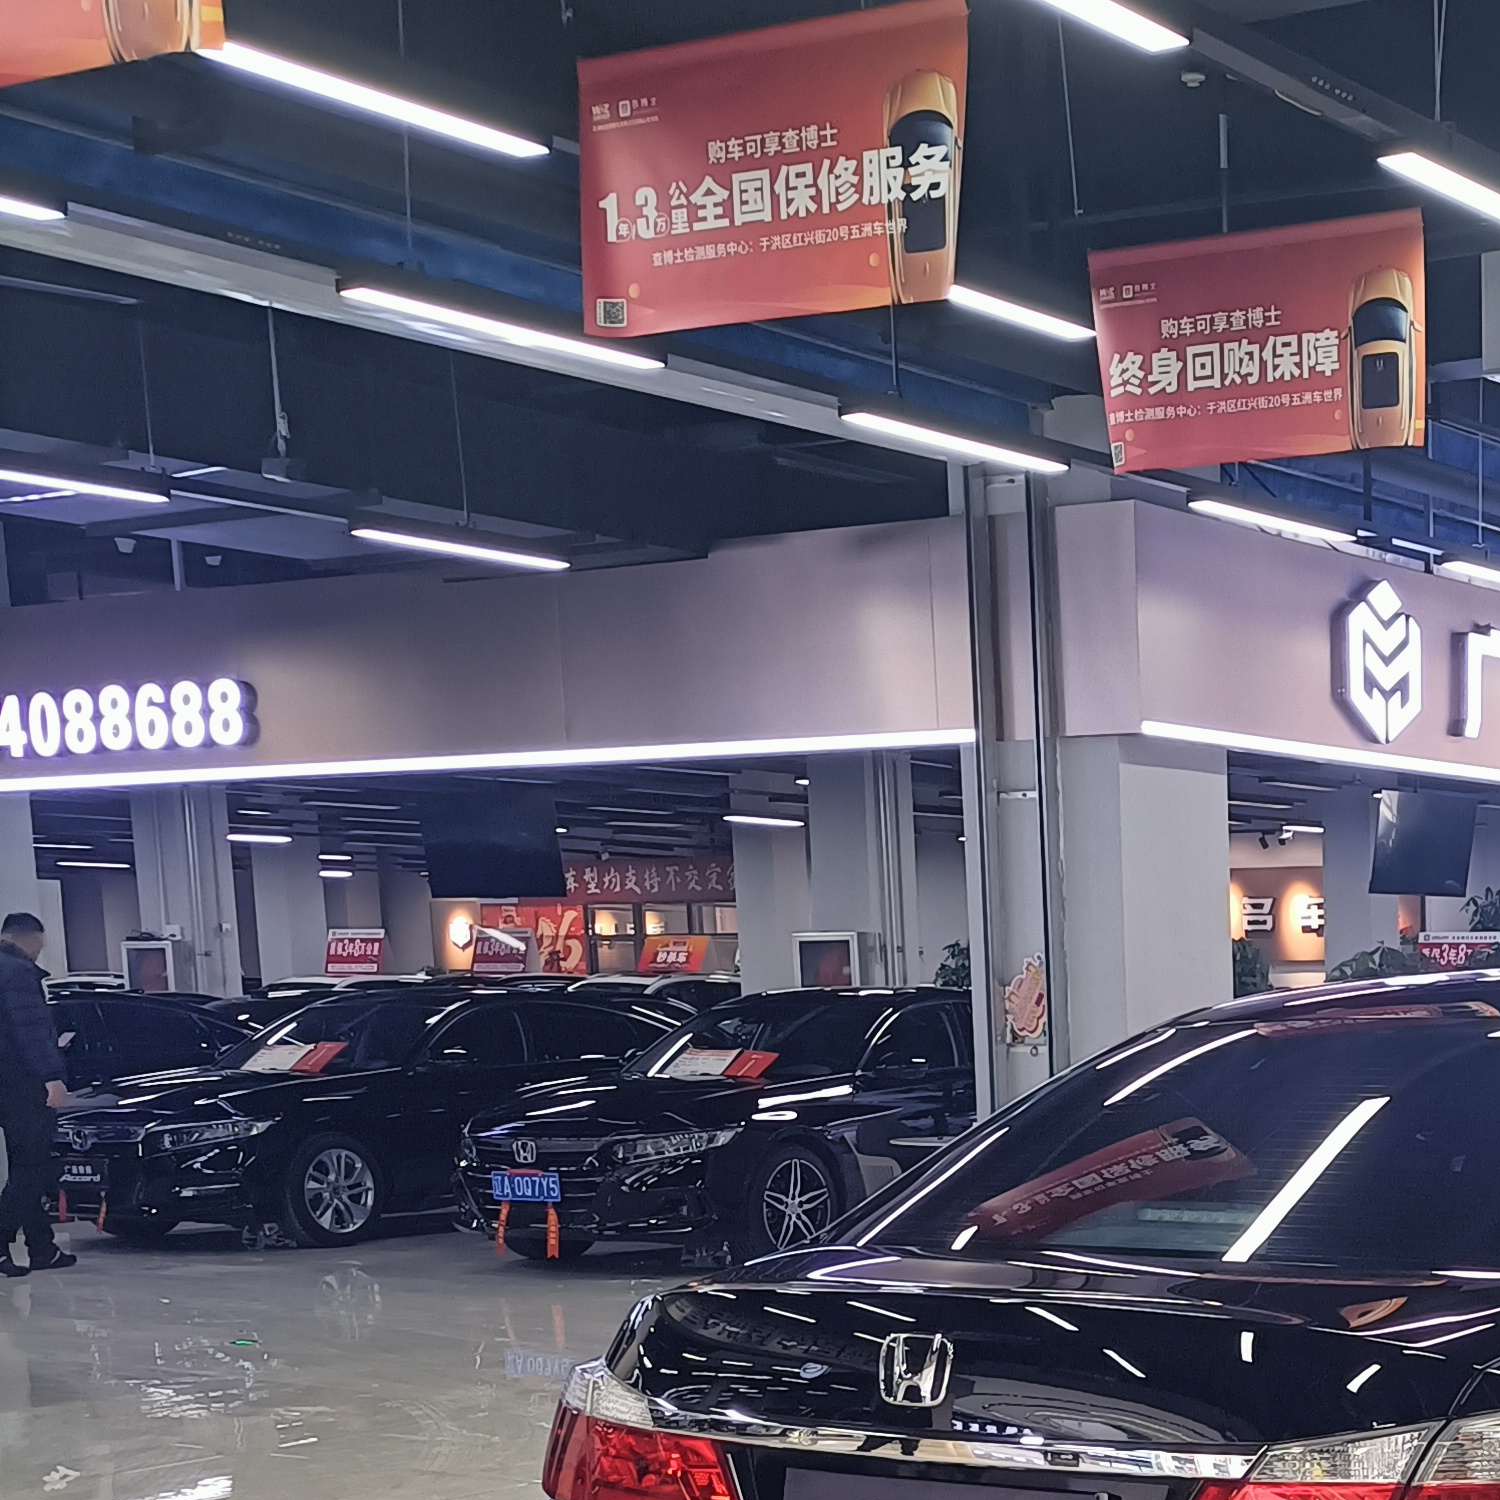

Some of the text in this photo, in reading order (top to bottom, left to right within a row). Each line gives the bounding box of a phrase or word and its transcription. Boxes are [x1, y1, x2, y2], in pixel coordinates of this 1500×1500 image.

[707, 122, 838, 165] 购车可享查博士
[1160, 305, 1282, 339] 购车可享查博士
[1109, 329, 1340, 397] 终身回购保障
